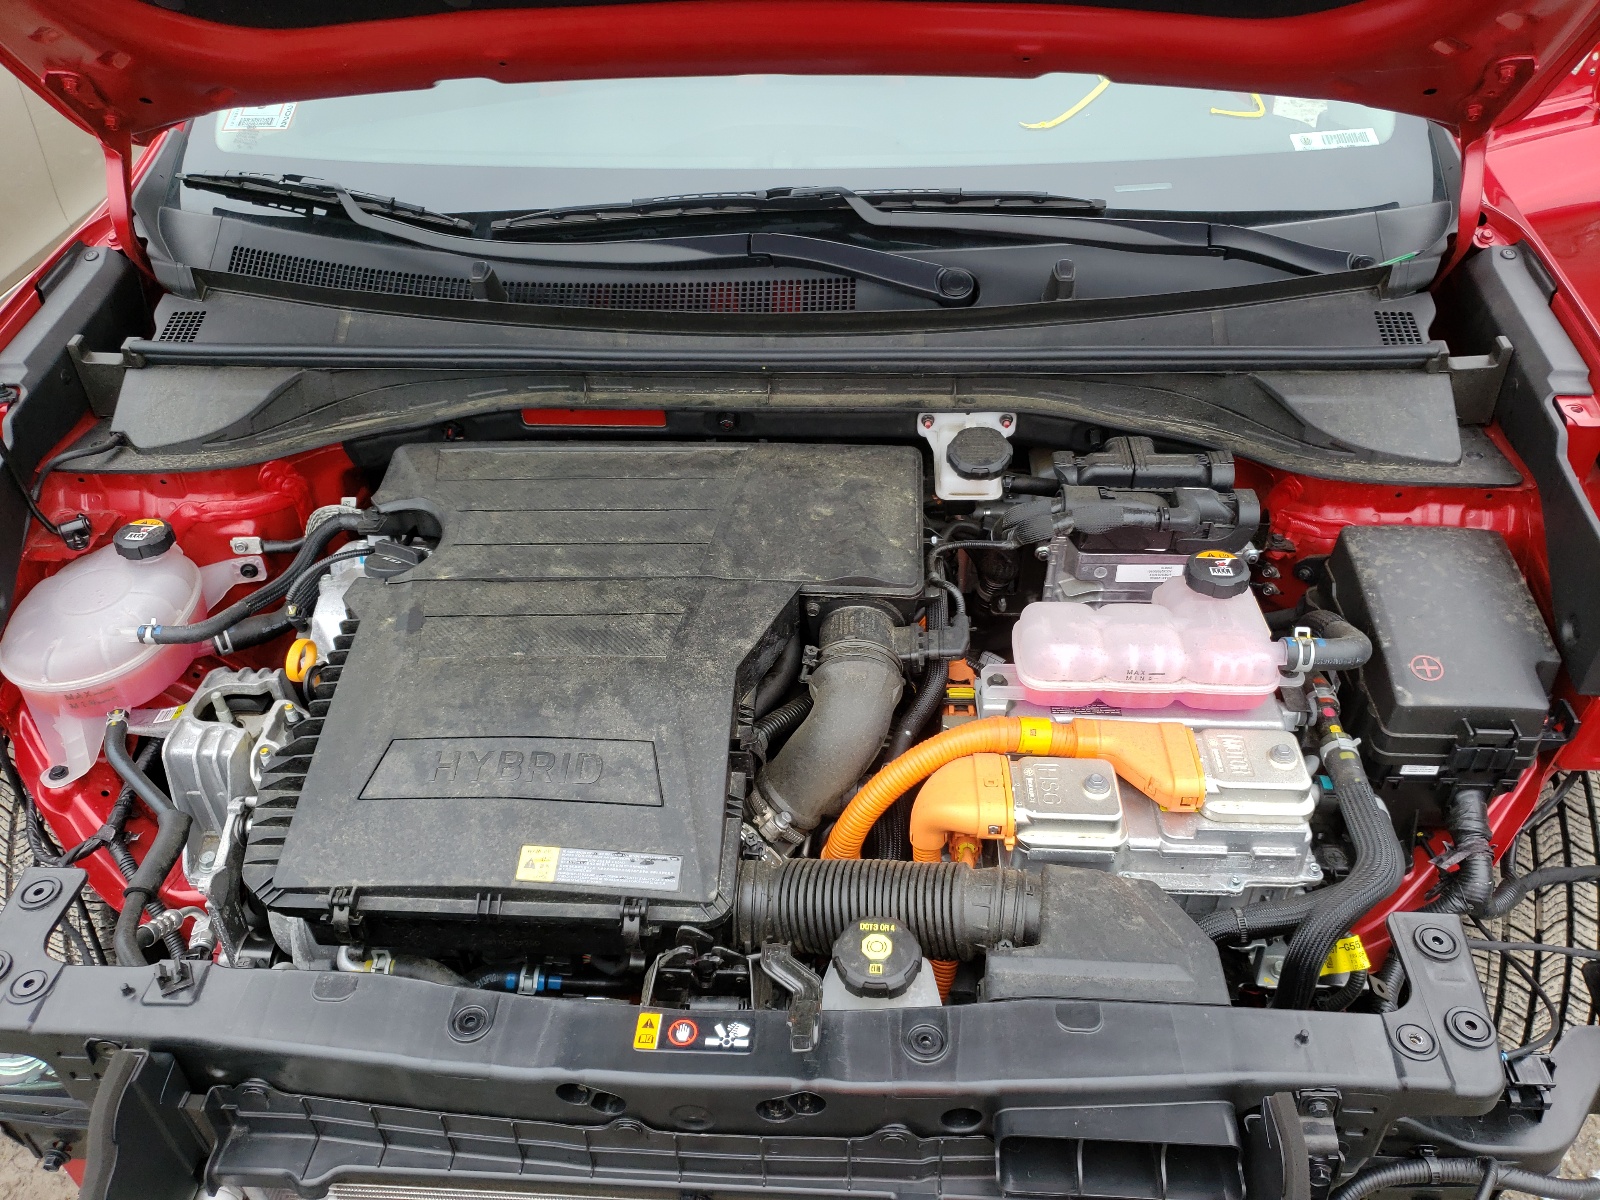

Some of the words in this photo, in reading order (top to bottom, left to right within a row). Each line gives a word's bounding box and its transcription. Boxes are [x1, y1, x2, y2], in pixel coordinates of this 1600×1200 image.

[64, 691, 90, 700] MAX
[69, 700, 96, 708] MIN
[1221, 738, 1252, 774] MOTOR
[429, 750, 604, 784] HYBRID
[1037, 768, 1061, 804] HSG
[880, 924, 889, 932] OR
